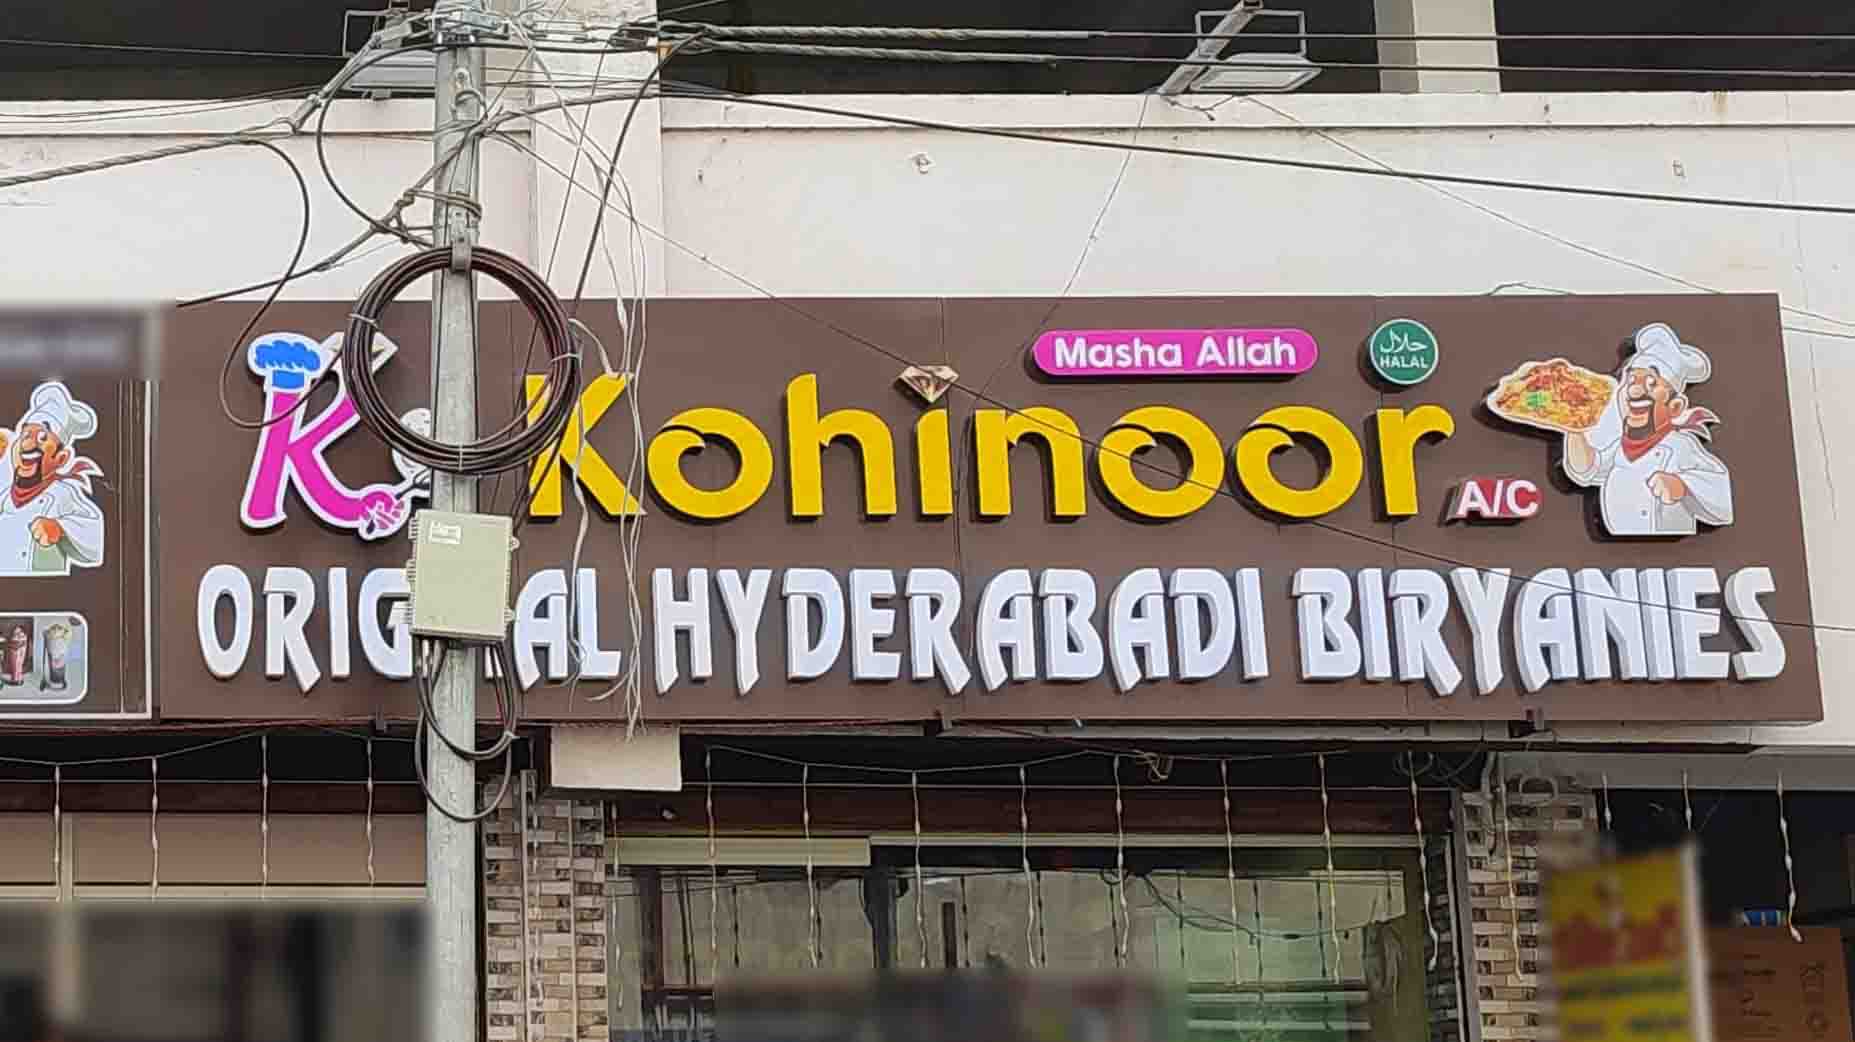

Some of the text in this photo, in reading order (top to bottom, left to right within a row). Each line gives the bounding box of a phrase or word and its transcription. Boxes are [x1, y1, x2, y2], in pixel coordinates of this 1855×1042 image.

[1053, 335, 1298, 369] Masha Allah
[1379, 328, 1428, 353] حلال
[1379, 355, 1429, 368] HALAL
[524, 372, 1456, 519] Kohinoor
[1456, 477, 1542, 519] A/C
[196, 563, 1787, 696] ORIGAL HYDERABADI BIRYANIES
